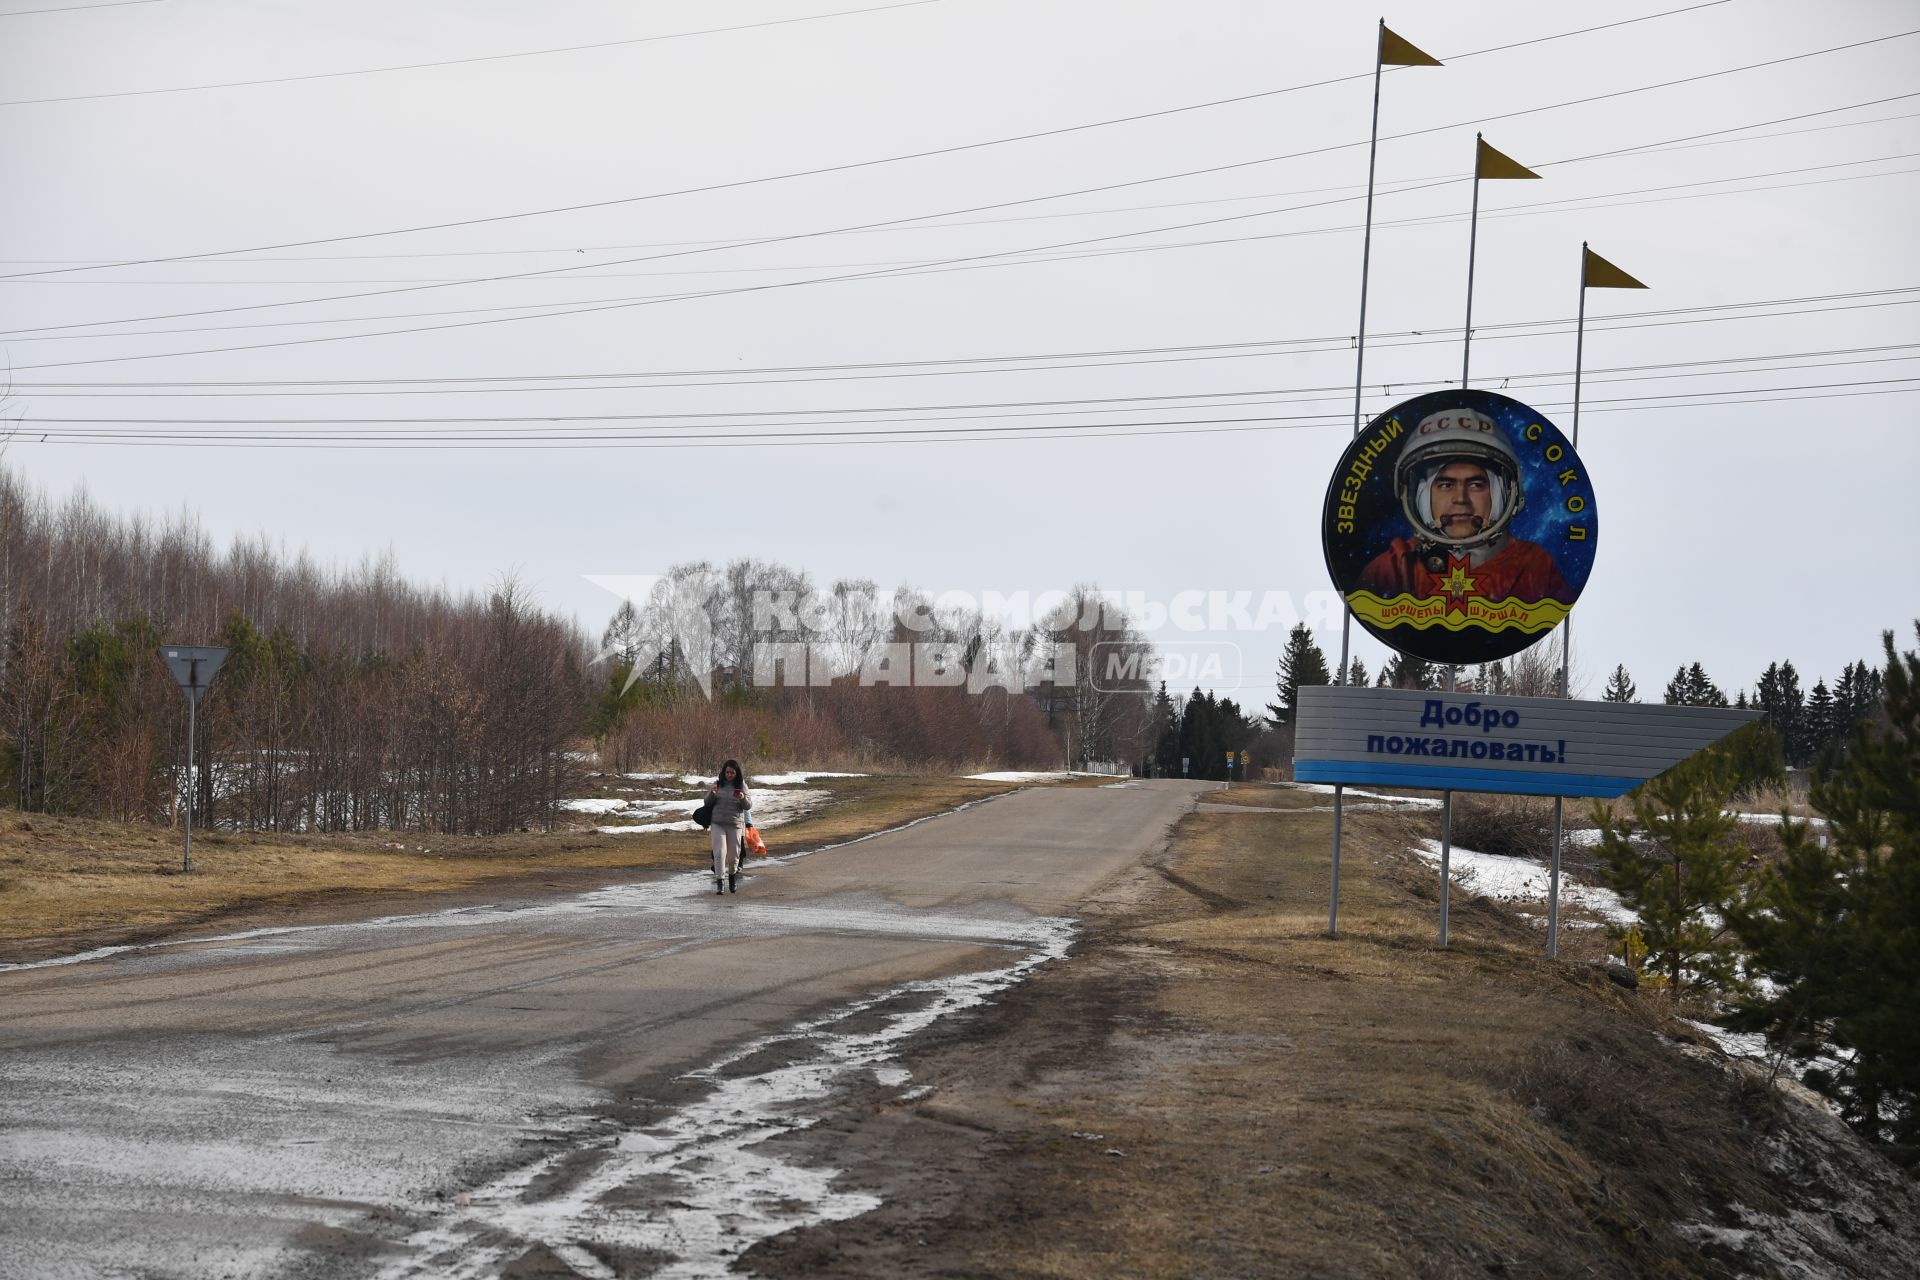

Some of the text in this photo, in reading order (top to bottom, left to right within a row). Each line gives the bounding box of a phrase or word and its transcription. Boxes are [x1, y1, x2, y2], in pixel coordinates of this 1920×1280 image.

[1420, 416, 1492, 434] СССР
[1338, 417, 1404, 533] ЗВЕЗДНЫЙ
[1526, 423, 1586, 541] СОКОЛ
[1381, 605, 1444, 619] ШОРШЕЛЫ
[1420, 700, 1520, 732] Добро
[1367, 734, 1566, 763] пожаловать!
